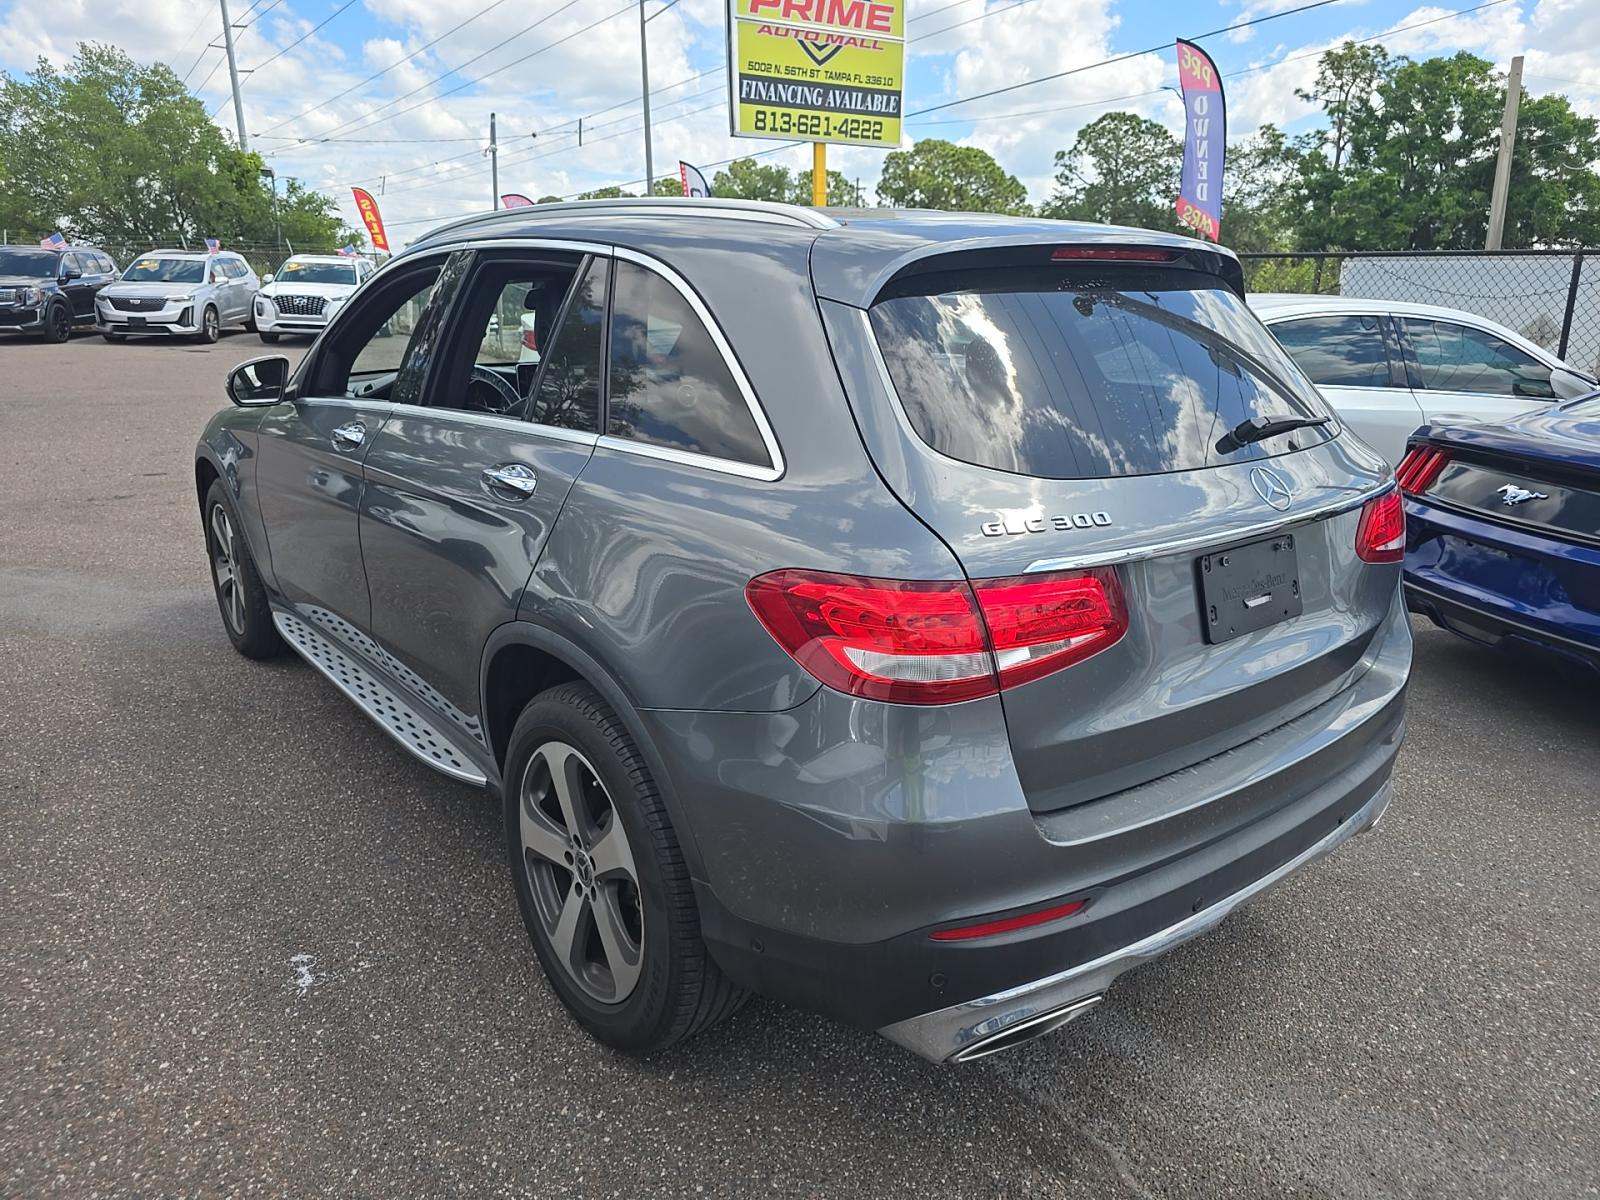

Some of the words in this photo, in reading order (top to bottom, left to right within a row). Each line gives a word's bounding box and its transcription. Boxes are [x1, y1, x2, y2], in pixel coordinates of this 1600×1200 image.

[750, 0, 894, 32] PRIME
[757, 24, 820, 42] AUTO
[826, 34, 884, 51] MALL
[748, 60, 772, 73] 5002
[774, 64, 782, 75] N.
[784, 65, 808, 77] 56TH
[809, 68, 821, 79] ST
[824, 70, 852, 82] TAMPA
[853, 73, 863, 84] FL
[865, 75, 894, 87] 33610
[740, 79, 823, 106] FINANCING
[825, 89, 899, 113] AVAILABLE
[1050, 511, 1113, 531] 300
